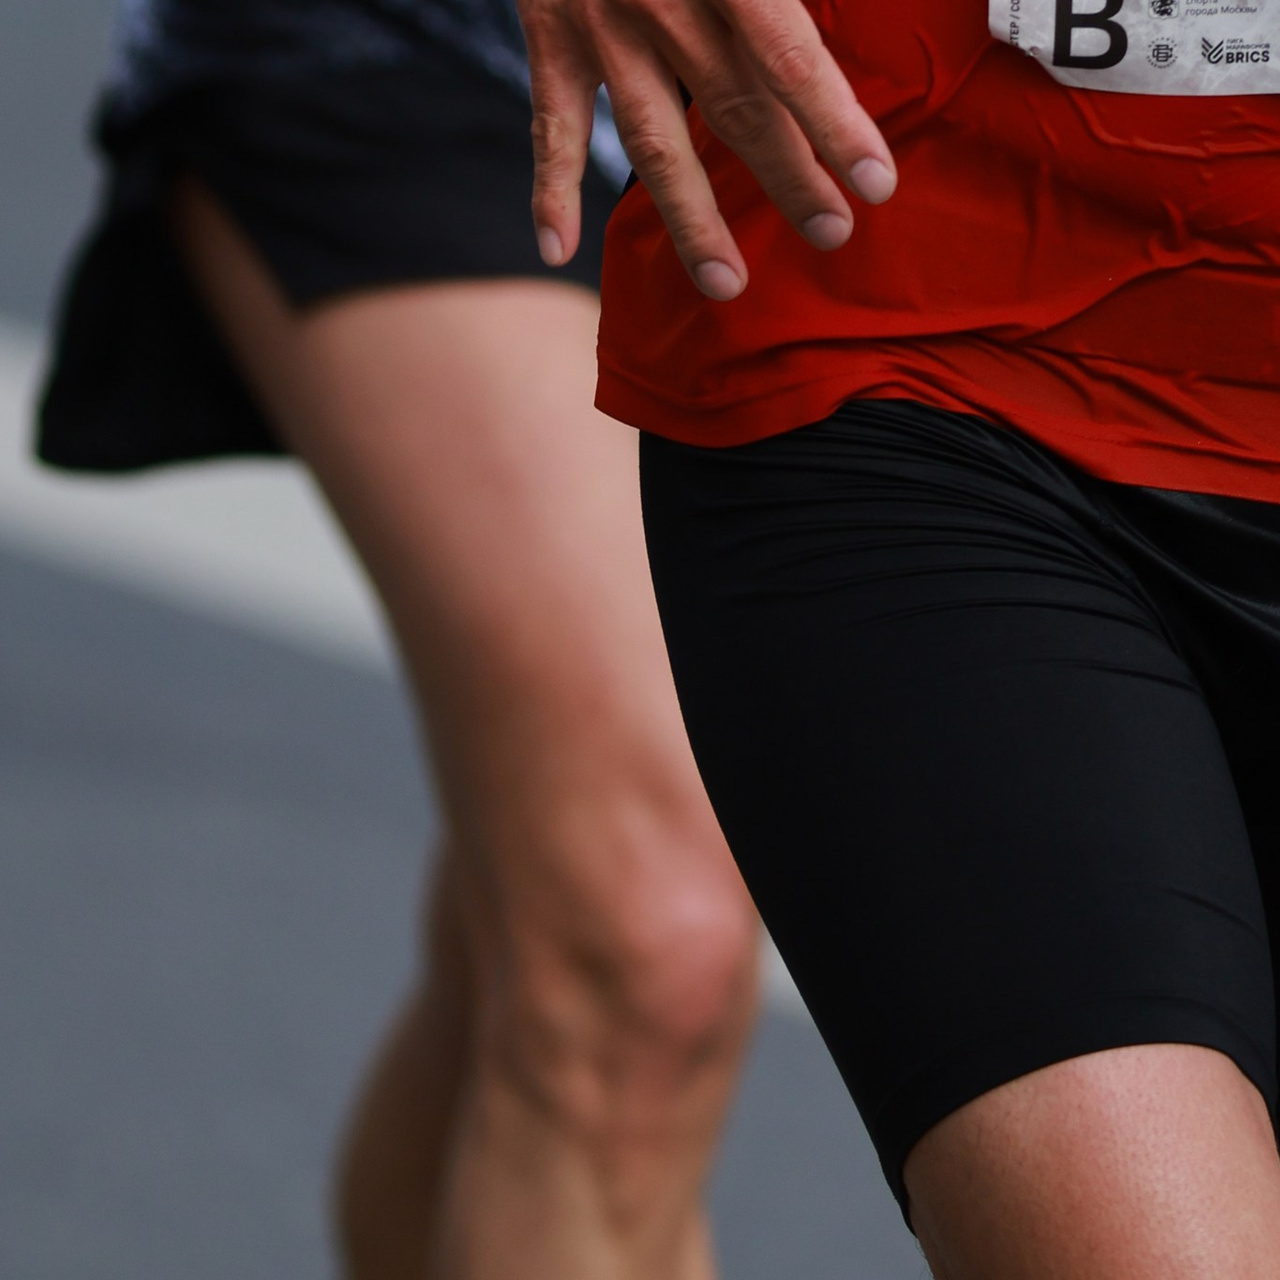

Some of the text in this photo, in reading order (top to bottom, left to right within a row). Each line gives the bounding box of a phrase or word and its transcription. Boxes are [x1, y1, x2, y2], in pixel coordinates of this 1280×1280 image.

[1185, 6, 1258, 16] города Москвы
[1226, 50, 1270, 64] BRICS
